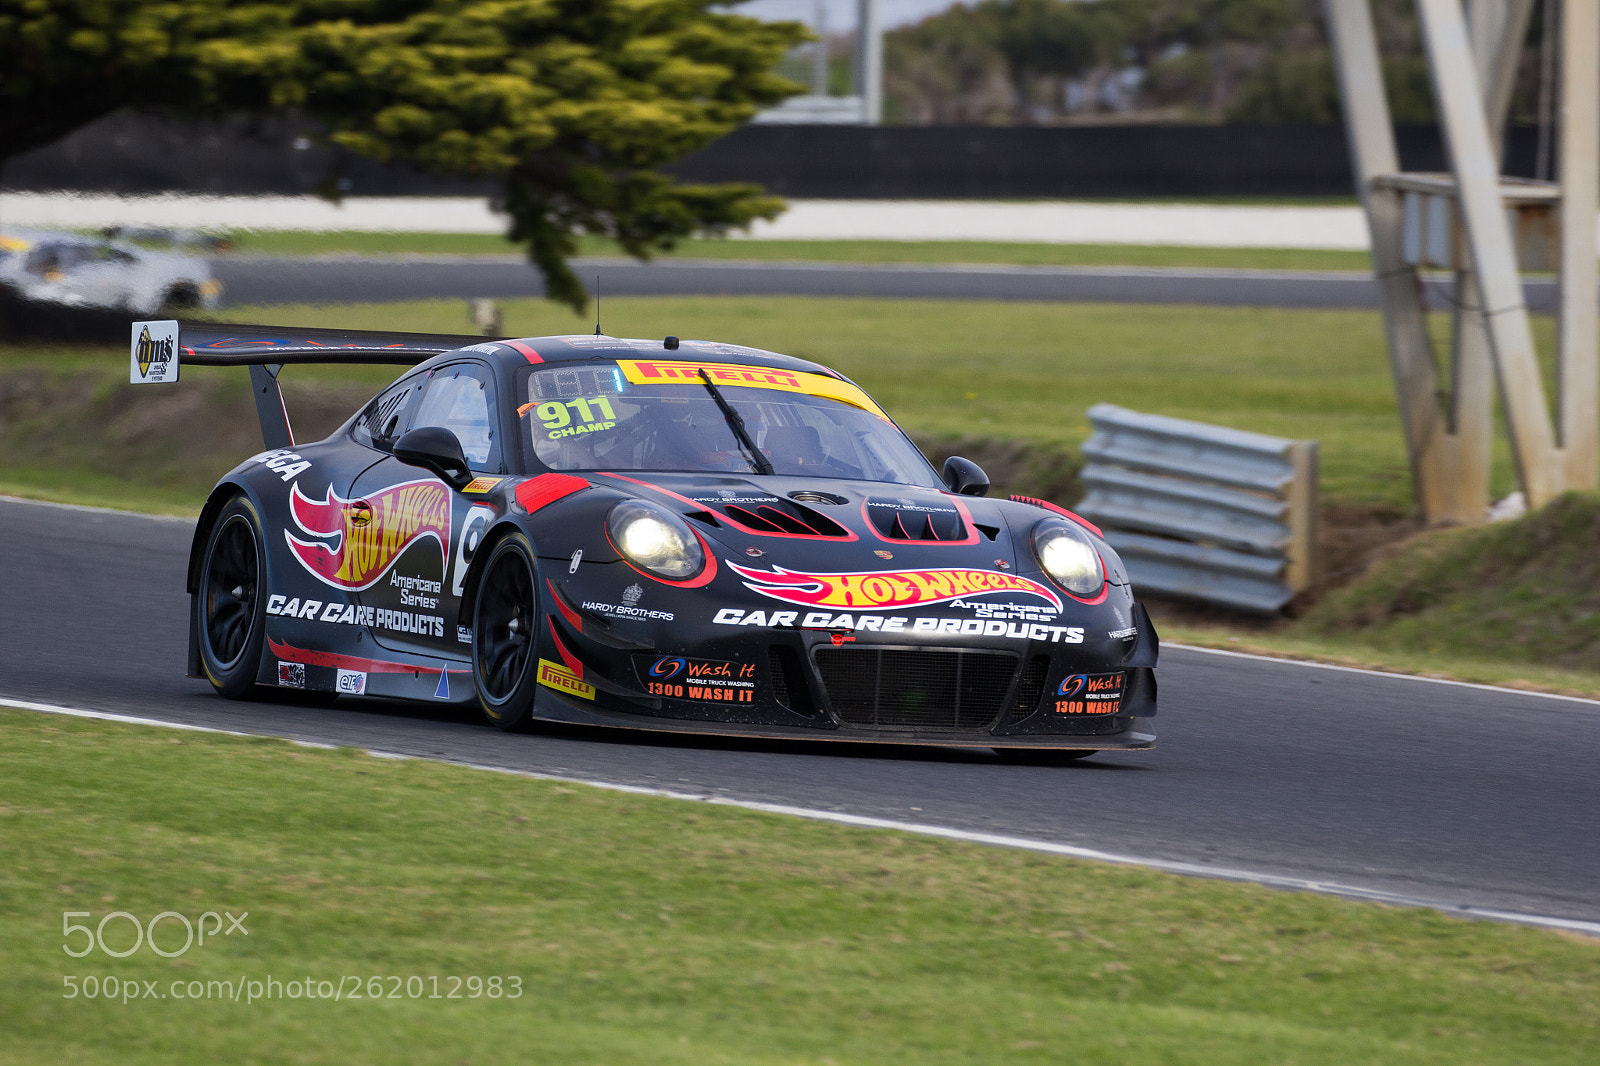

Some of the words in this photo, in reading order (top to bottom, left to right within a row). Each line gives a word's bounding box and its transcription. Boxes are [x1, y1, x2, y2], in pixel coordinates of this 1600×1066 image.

[634, 362, 802, 388] PIRELLI
[537, 395, 617, 429] 911
[548, 421, 616, 439] CHAMP
[467, 479, 498, 490] PIRELLI
[333, 503, 382, 582] HOT
[379, 485, 448, 570] WHEELS
[390, 569, 442, 594] Americana
[815, 575, 917, 607] HOT
[898, 571, 1034, 602] WHEELS
[400, 588, 436, 609] Series
[949, 599, 1058, 614] Americana
[266, 594, 322, 620] CAR
[319, 602, 375, 627] CARE
[376, 608, 444, 637] PRODUCTS
[581, 601, 617, 612] HARDY
[616, 605, 675, 621] BROTHERS
[975, 608, 1052, 622] Series
[712, 608, 799, 627] CAR
[801, 612, 908, 632] CARE
[912, 617, 1085, 644] PRODUCTS
[542, 664, 590, 694] PIRELLI
[688, 662, 731, 677] Wash
[340, 674, 357, 690] elf
[727, 680, 755, 688] WASHING
[1088, 675, 1113, 692] Wash
[648, 682, 683, 698] 1300
[688, 686, 734, 701] WASH
[738, 689, 755, 703] IT
[1055, 701, 1083, 713] 1300
[1086, 701, 1112, 714] WASH
[1112, 701, 1120, 713] IT
